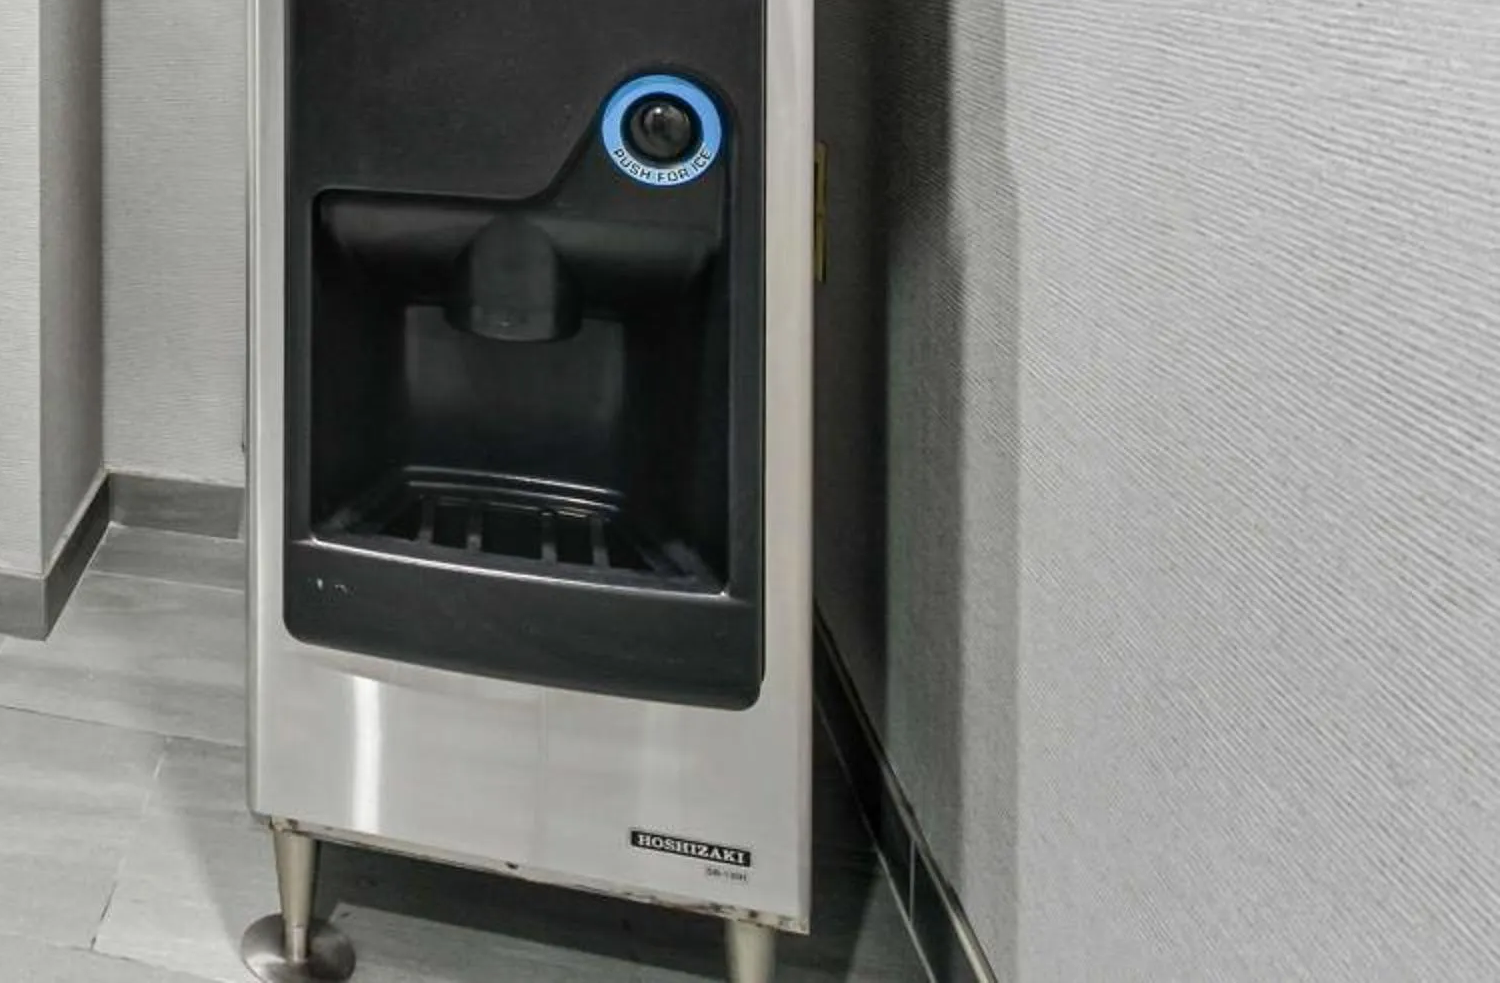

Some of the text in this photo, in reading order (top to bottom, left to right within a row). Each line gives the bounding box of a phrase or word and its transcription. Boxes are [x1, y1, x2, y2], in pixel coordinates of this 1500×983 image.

[613, 147, 714, 183] PUSH FOR ICE
[637, 833, 746, 865] HOSHIZAKI
